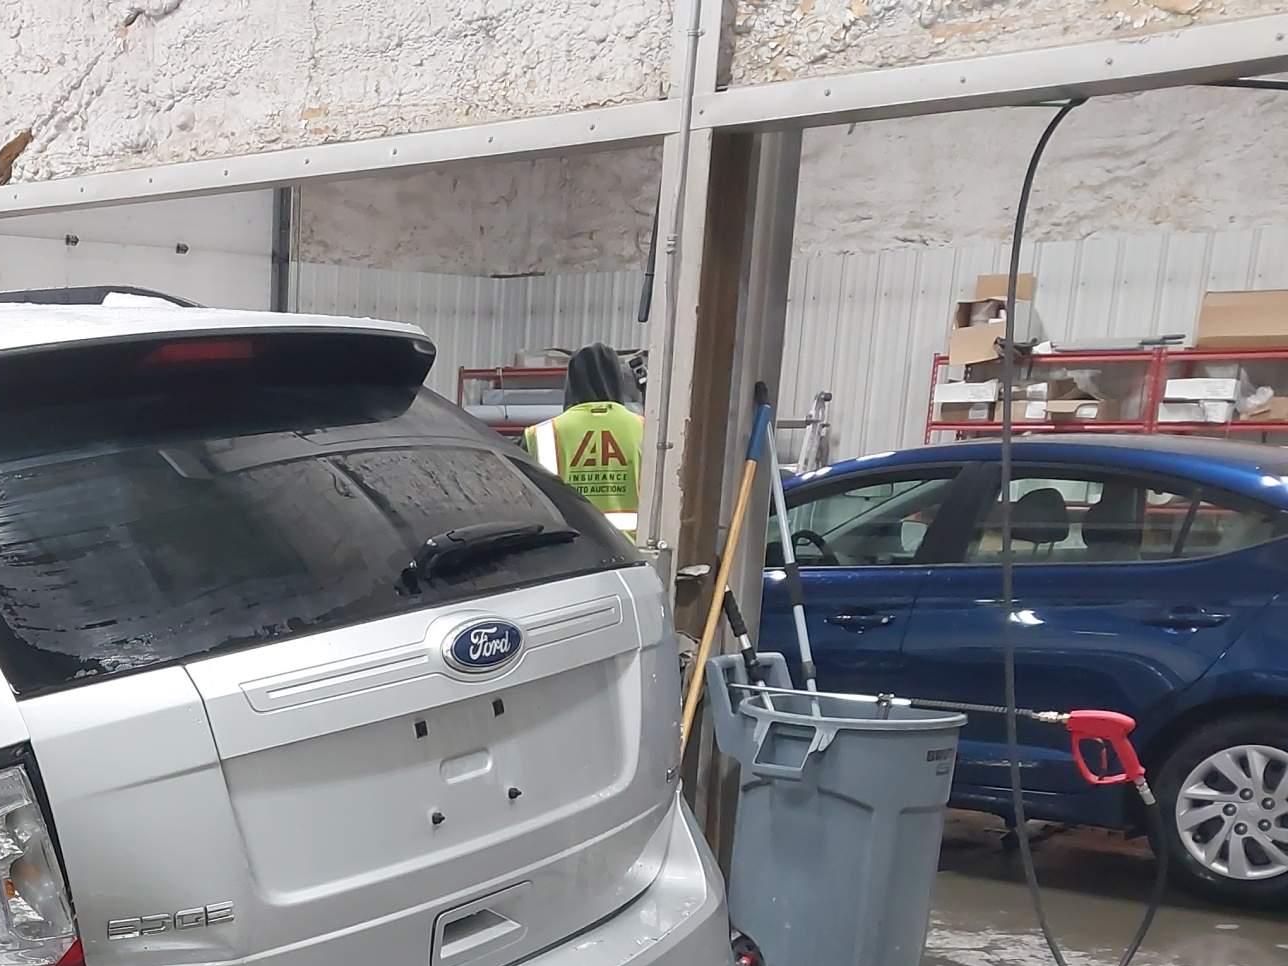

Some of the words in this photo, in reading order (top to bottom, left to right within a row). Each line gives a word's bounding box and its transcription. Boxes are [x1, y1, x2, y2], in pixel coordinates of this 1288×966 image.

[569, 474, 627, 482] INSURANCE
[590, 485, 626, 494] AUCTIONS
[469, 627, 511, 660] Ford
[108, 900, 234, 940] EDGE
